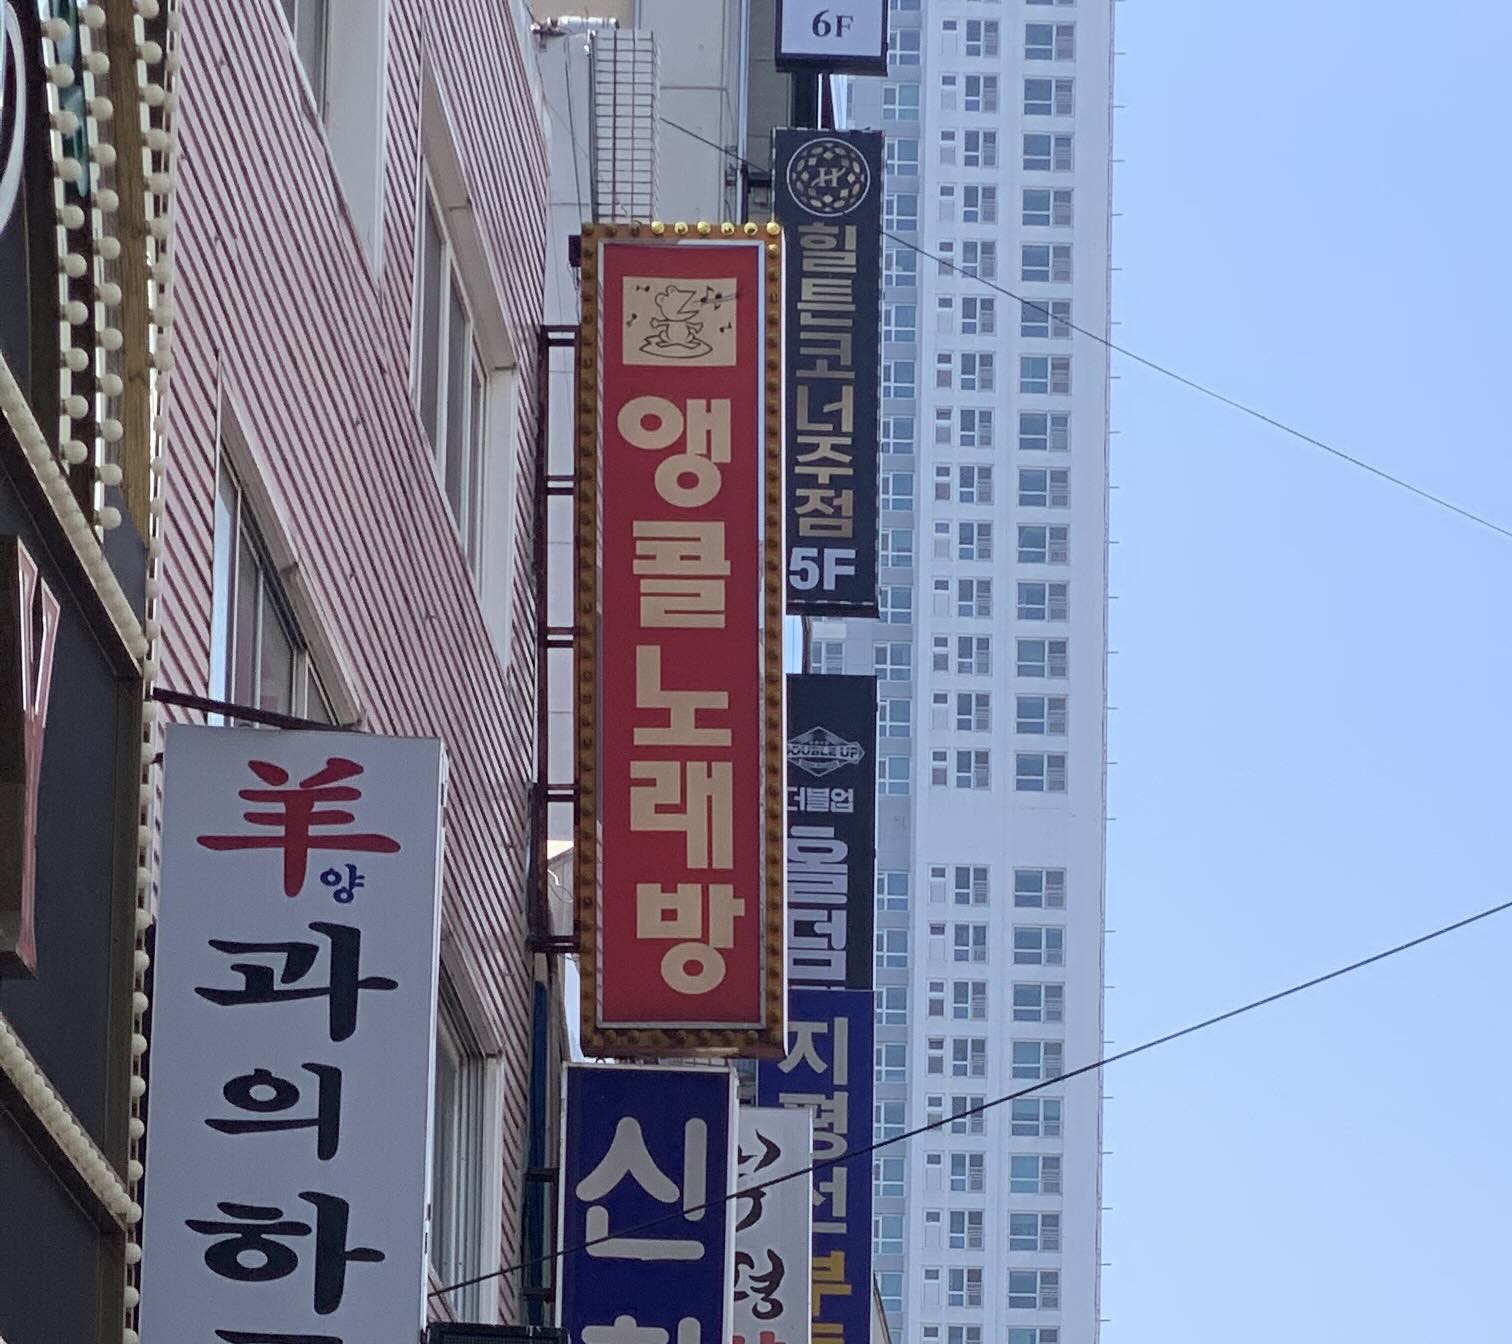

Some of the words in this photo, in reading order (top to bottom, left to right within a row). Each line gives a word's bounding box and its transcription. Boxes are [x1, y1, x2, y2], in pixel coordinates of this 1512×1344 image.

[812, 10, 853, 38] 6F
[794, 224, 858, 541] 힐튼코너주점
[789, 549, 857, 590] 5F
[617, 396, 745, 995] 앵콜노래방
[196, 757, 402, 898] 羊
[320, 863, 366, 905] 양
